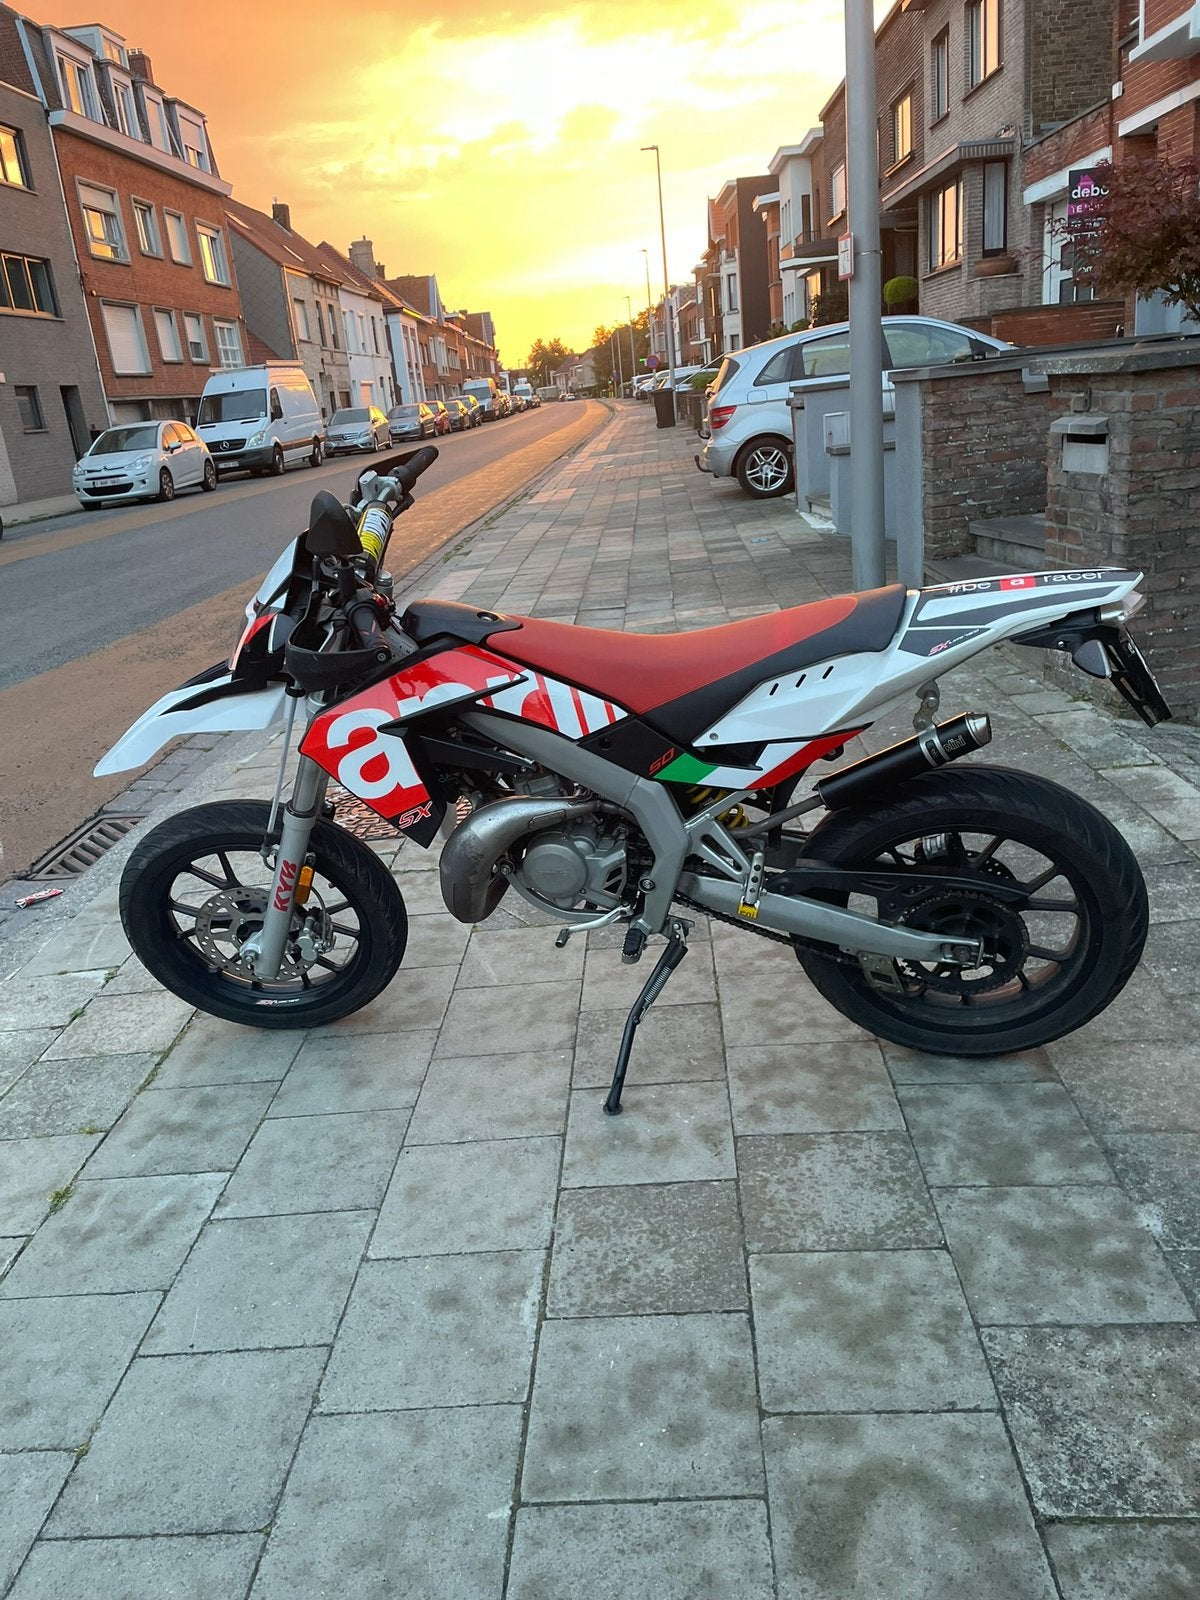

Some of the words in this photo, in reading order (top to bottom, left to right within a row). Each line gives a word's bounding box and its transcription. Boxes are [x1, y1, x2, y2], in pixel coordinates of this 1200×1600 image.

[1010, 577, 1025, 586] a
[1043, 571, 1106, 583] racer
[398, 800, 433, 830] SX
[273, 859, 297, 912] KYB
